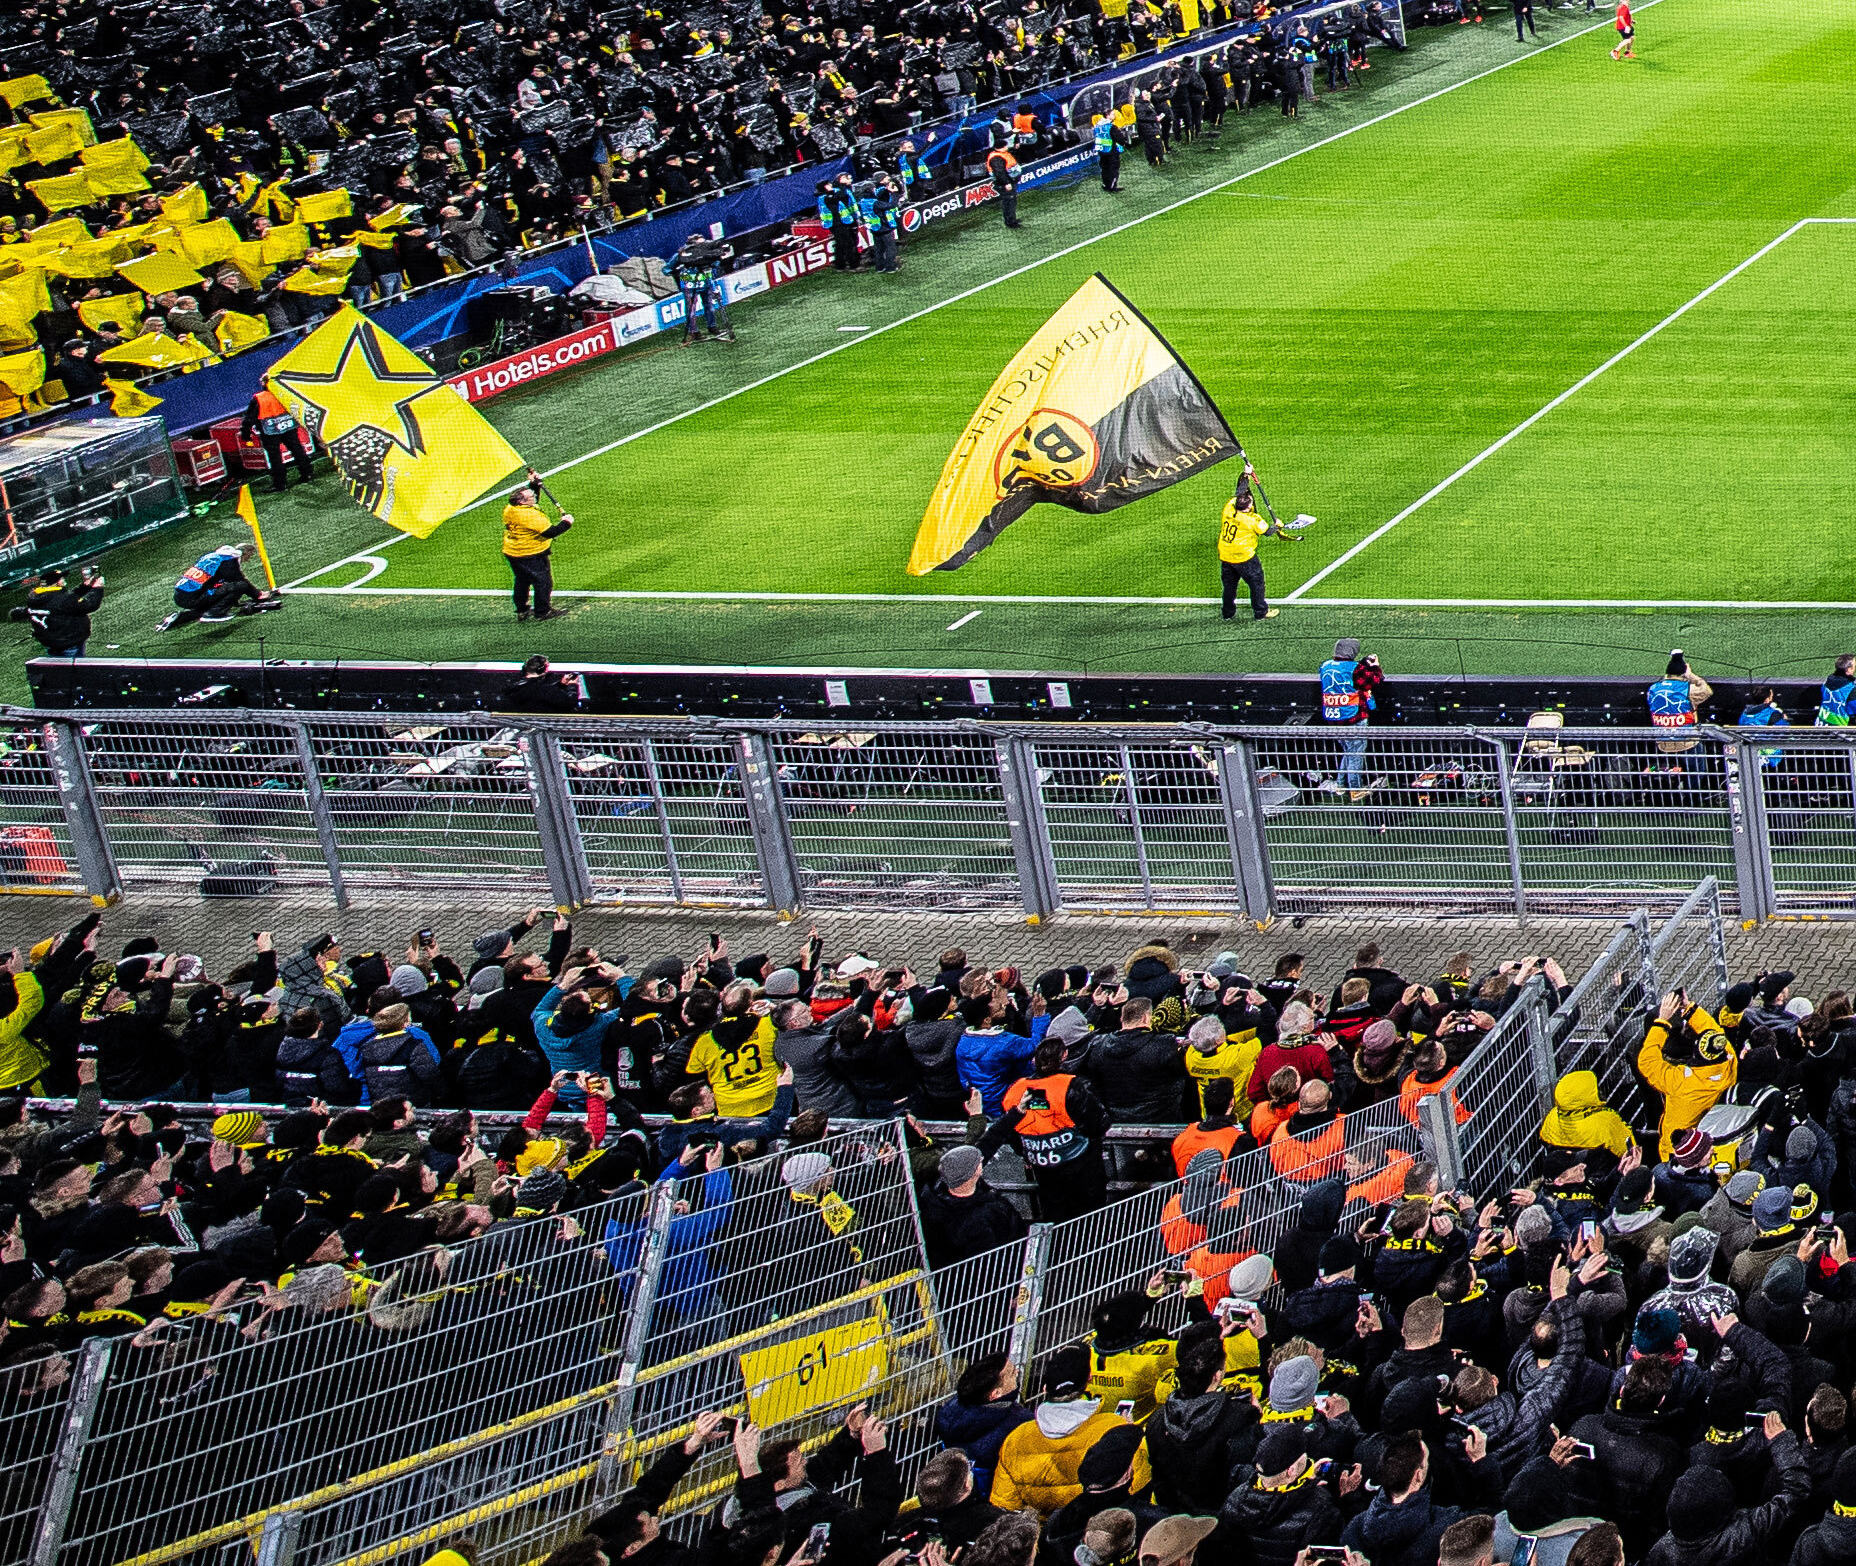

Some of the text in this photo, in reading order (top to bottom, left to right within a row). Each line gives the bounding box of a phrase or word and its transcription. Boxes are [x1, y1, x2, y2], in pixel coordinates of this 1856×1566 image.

[1035, 154, 1079, 178] CHAMPIONS
[922, 182, 1000, 225] pepsi MAX
[474, 331, 607, 400] Hotels.com
[1652, 711, 1686, 727] PHOTO
[721, 1042, 763, 1082] 23
[797, 1340, 828, 1387] 61
